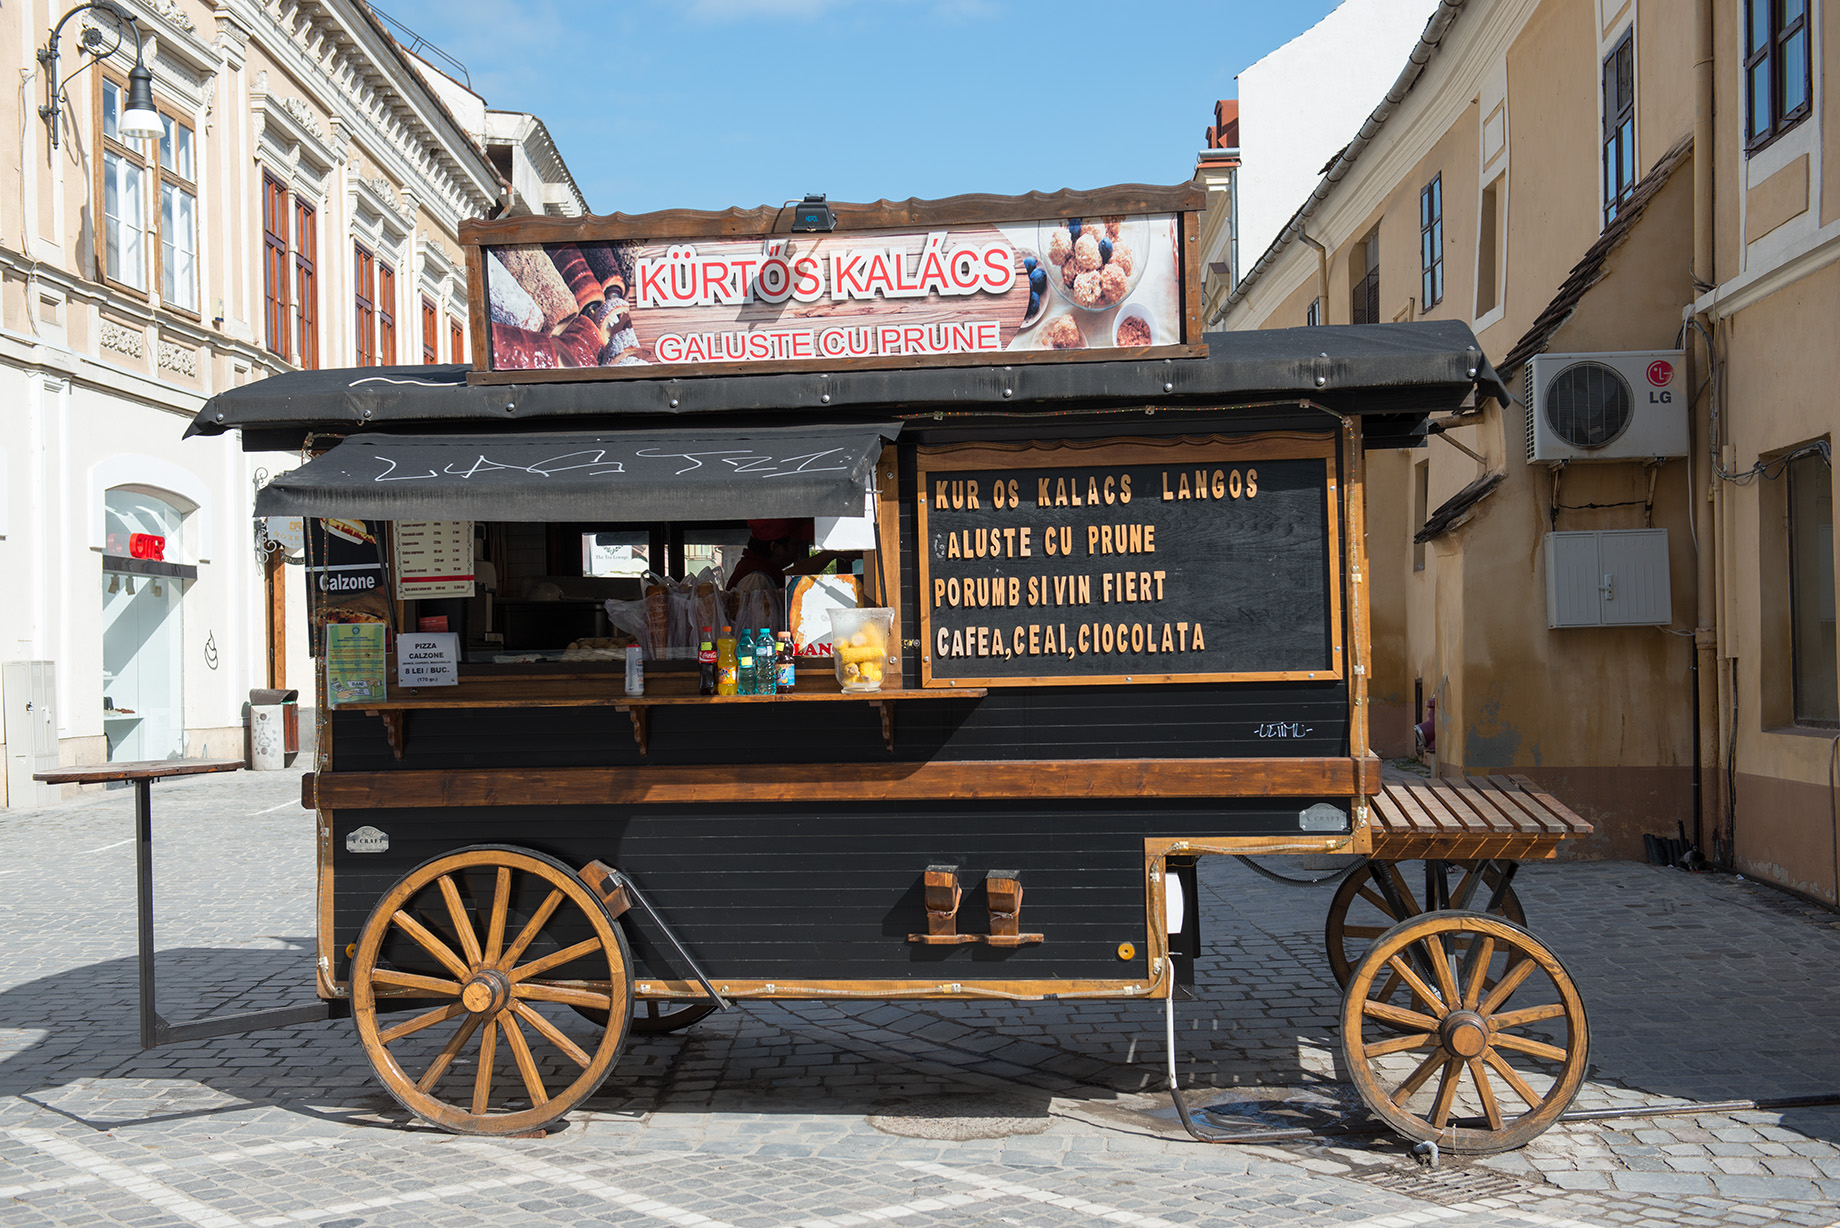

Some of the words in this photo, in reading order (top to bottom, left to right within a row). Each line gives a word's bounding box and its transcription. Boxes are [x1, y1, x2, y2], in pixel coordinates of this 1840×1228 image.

[639, 244, 822, 303] KÜRTŐS
[834, 236, 1012, 295] KALÁCS
[657, 331, 813, 362] GALUSTE
[822, 329, 869, 356] CU
[881, 324, 999, 353] PRUNE
[1649, 391, 1672, 404] LG
[1037, 473, 1133, 506] KALACS
[1162, 468, 1258, 500] LANGOS
[1044, 525, 1073, 556] CU
[1087, 523, 1156, 555] PRUNE
[318, 573, 376, 591] Calzone
[933, 576, 1021, 608] PORUMB
[1102, 570, 1167, 603] FIERT
[414, 642, 438, 650] PIZZA
[793, 642, 834, 656] LAN
[408, 651, 445, 660] CALZONE
[411, 667, 424, 675] LEI
[430, 666, 450, 674] BUC.
